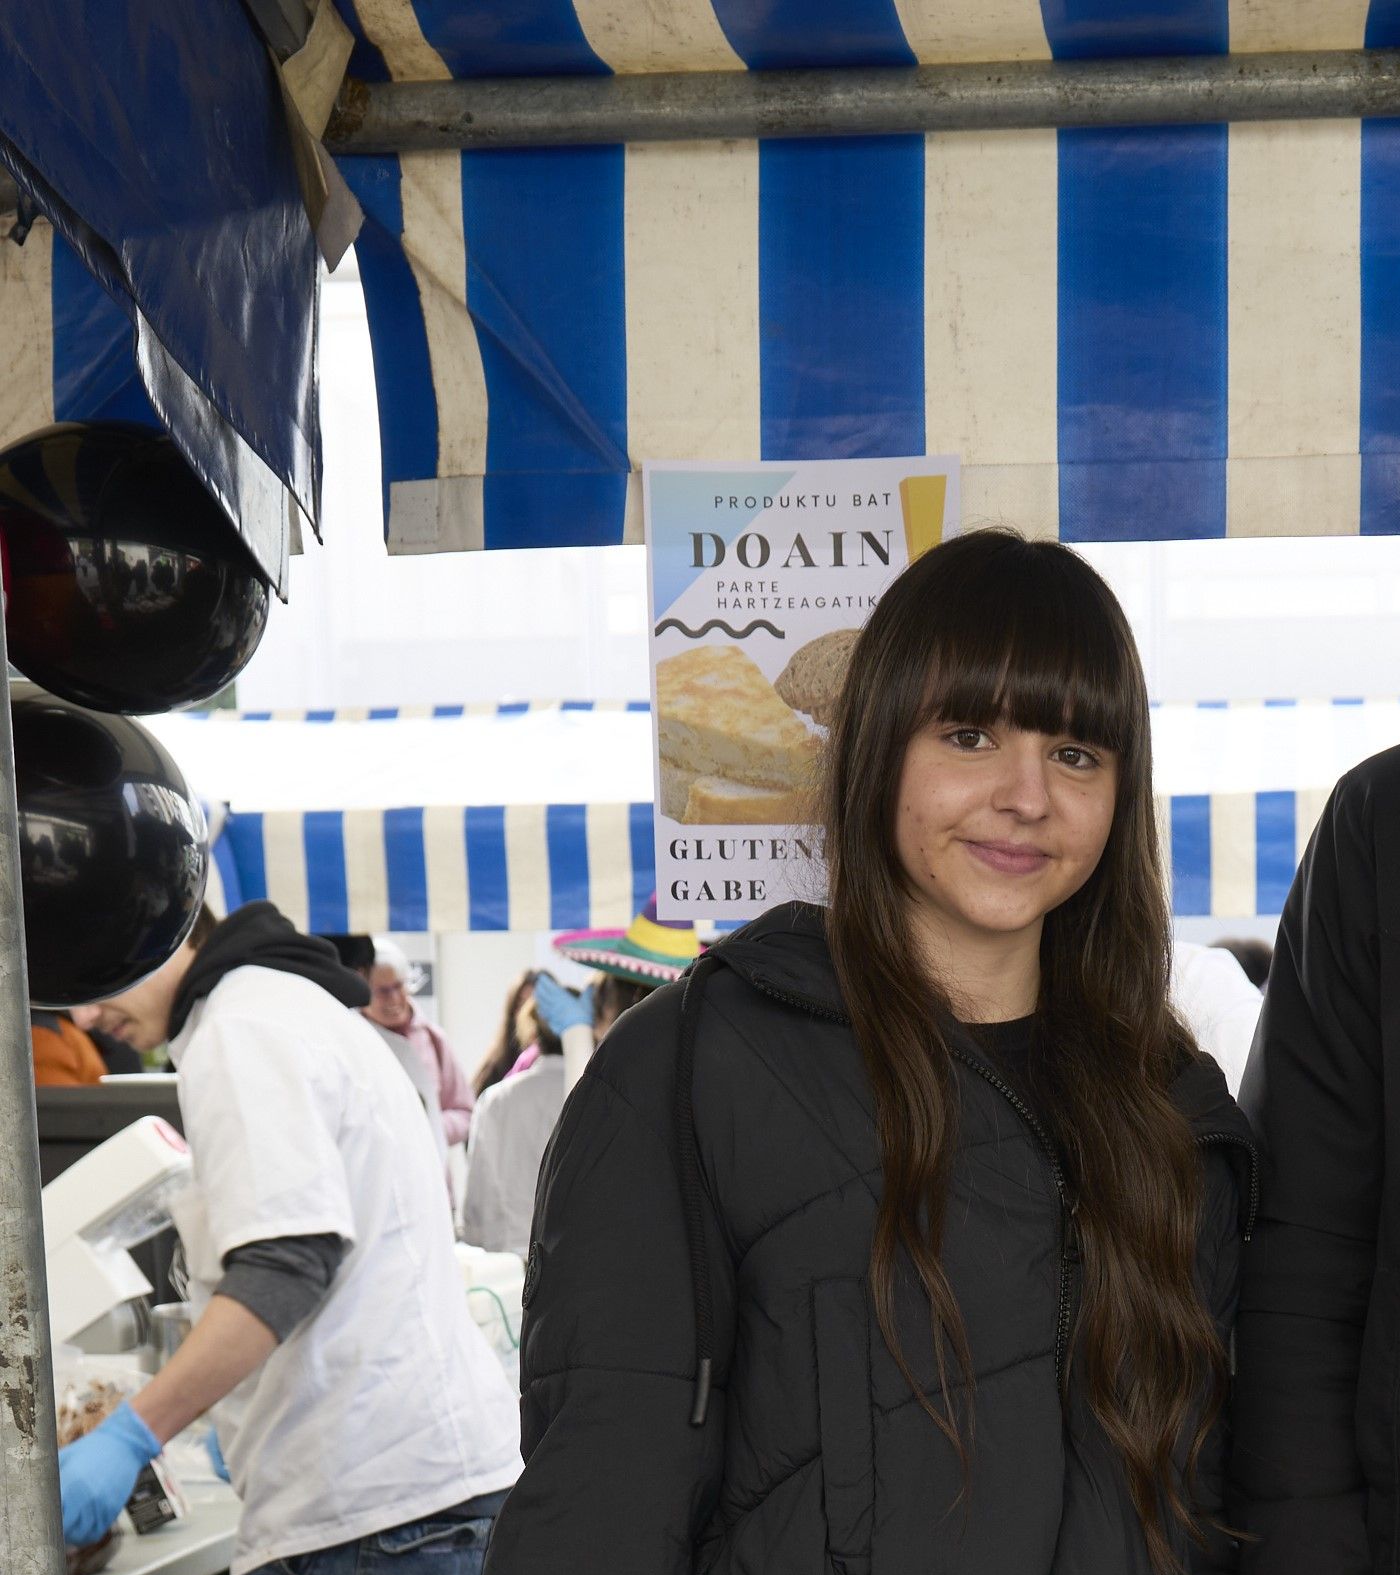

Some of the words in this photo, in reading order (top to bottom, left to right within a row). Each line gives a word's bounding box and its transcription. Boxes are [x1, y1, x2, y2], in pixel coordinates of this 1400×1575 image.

[713, 494, 837, 510] PRODUKTU
[852, 492, 892, 507] BAT
[688, 529, 894, 569] DOAIN
[716, 580, 780, 593] PARTE
[716, 594, 879, 609] HARTZEAGATIK
[670, 878, 768, 901] GABE
